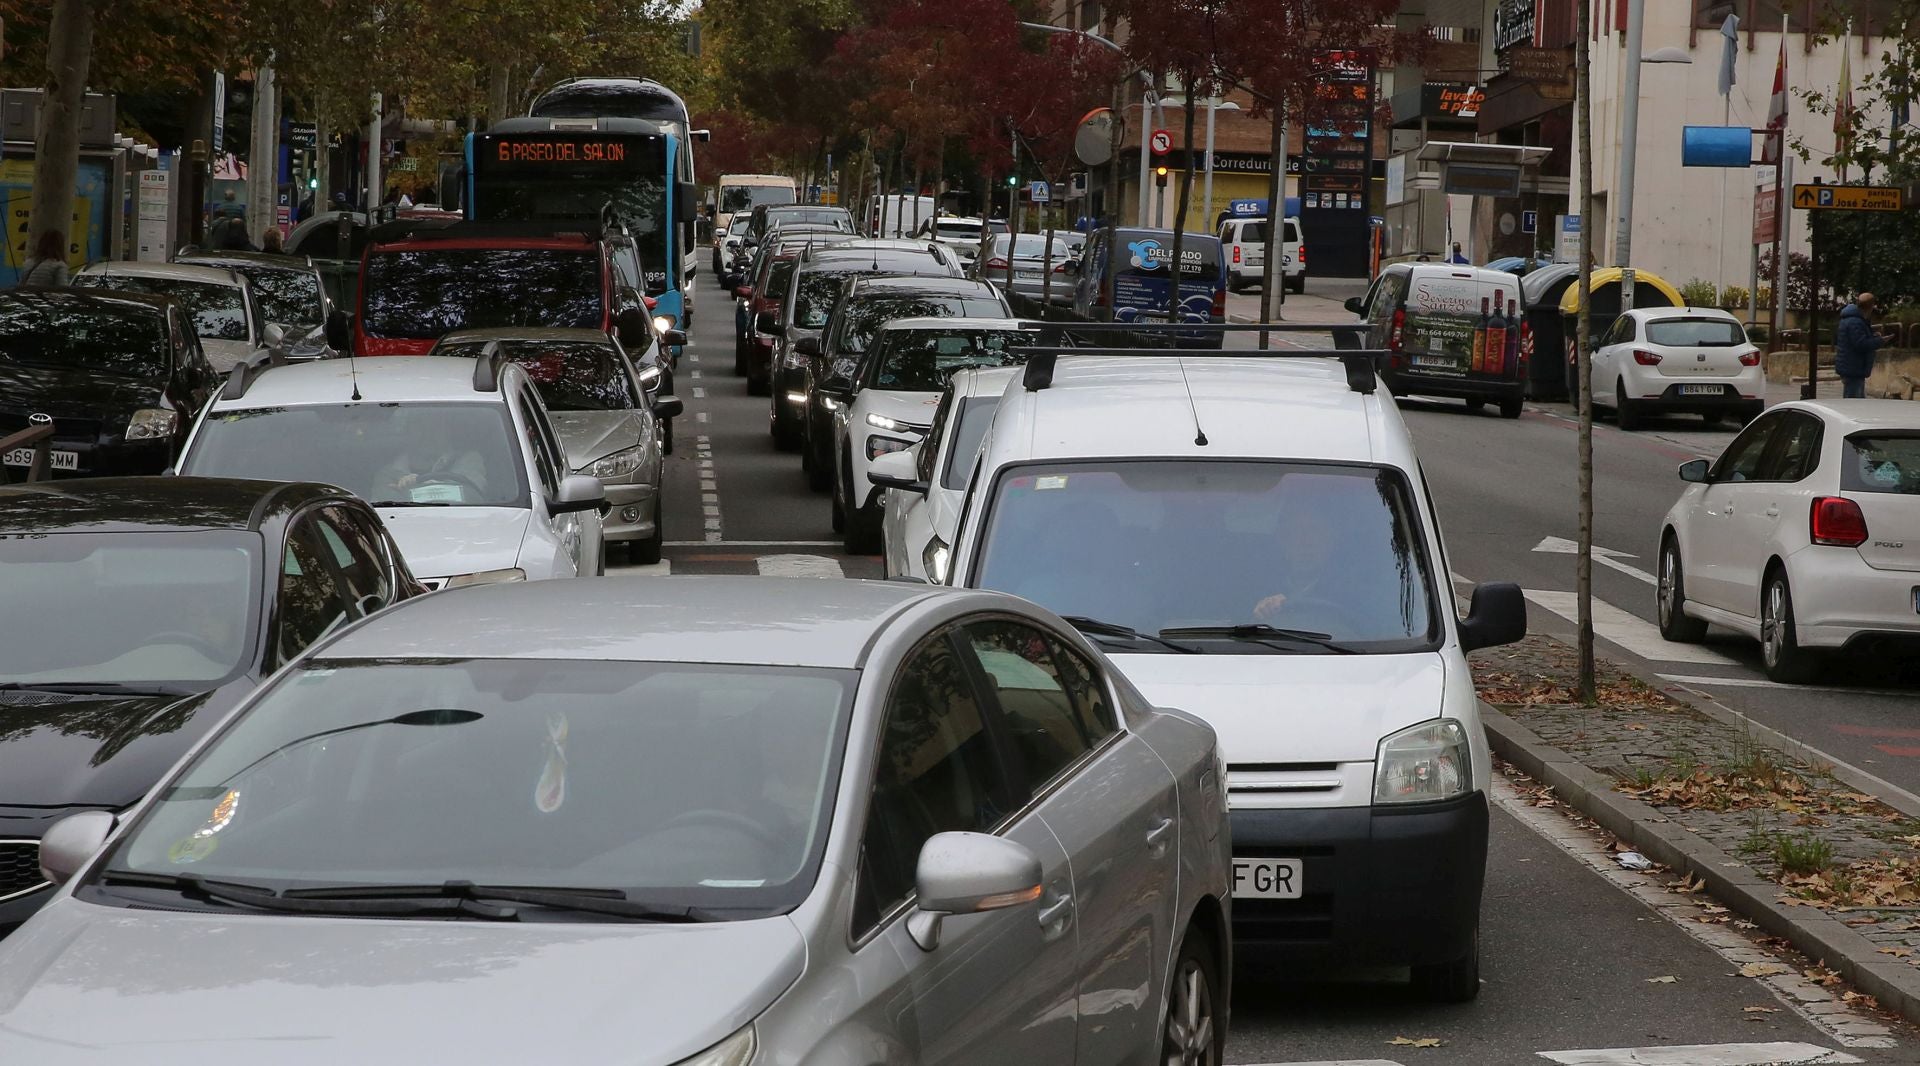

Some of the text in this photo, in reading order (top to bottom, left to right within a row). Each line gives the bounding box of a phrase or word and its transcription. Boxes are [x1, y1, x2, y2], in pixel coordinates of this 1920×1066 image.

[1440, 88, 1485, 101] lavado
[1440, 102, 1448, 111] a
[499, 142, 624, 161] 6 PASEO DEL SALON
[1820, 190, 1897, 205] P parking
[1835, 199, 1897, 209] José Zorrilla
[1149, 248, 1202, 260] DEL PADO
[1232, 864, 1294, 893] FGR
